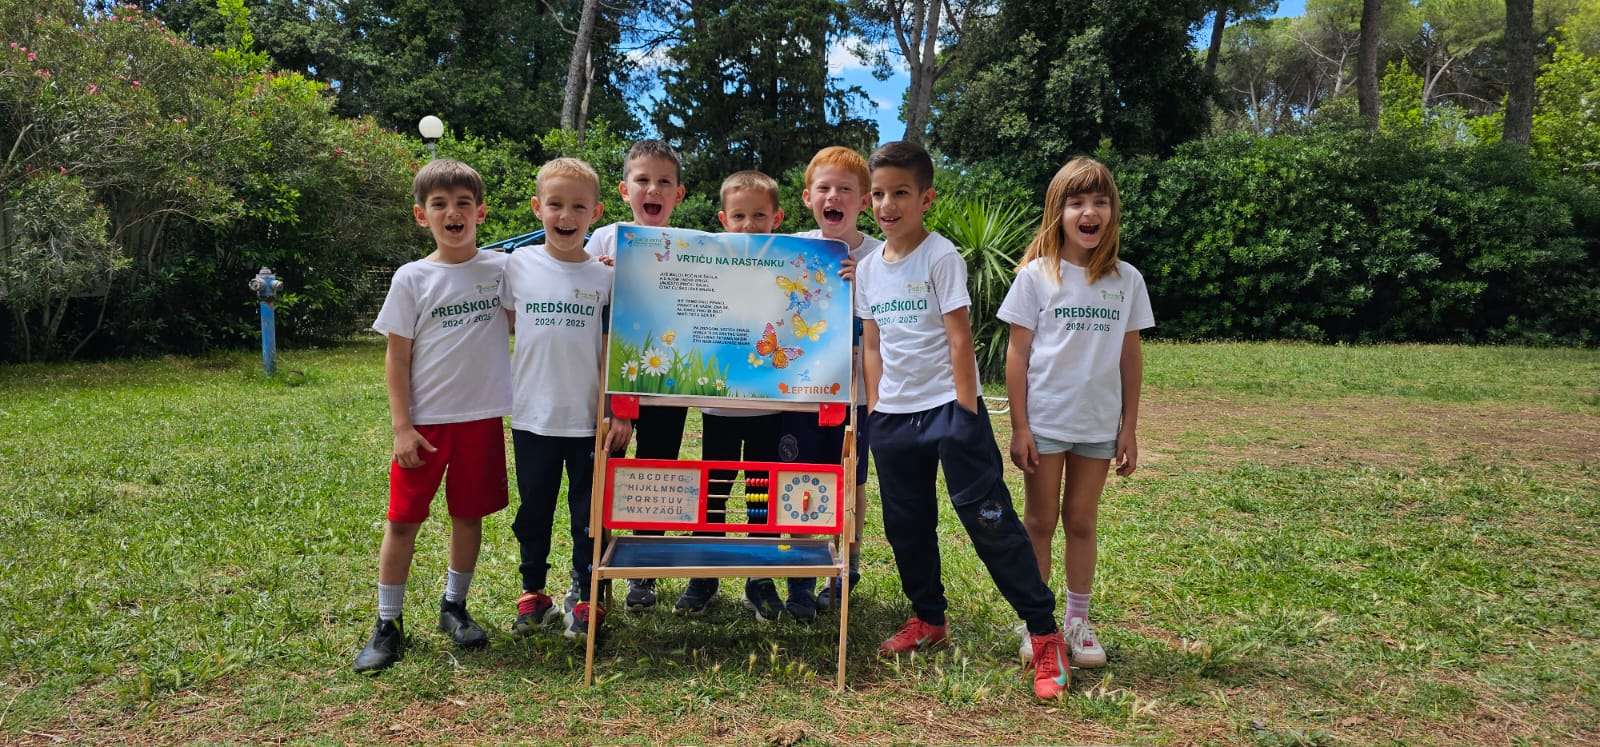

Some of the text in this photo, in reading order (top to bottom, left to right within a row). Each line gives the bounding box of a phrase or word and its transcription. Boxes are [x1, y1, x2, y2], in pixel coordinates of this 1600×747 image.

[676, 253, 785, 268] VRTIĆU NA RASTANKU
[525, 302, 594, 316] PREDŠKOLCI
[870, 299, 928, 315] PREDŠKOLCI
[1054, 305, 1120, 321] PREDŠKOLCI
[442, 319, 464, 329] 2024
[535, 318, 556, 326] 2024
[566, 319, 585, 328] 2025
[898, 316, 918, 324] 2025
[1065, 322, 1085, 331] 2024
